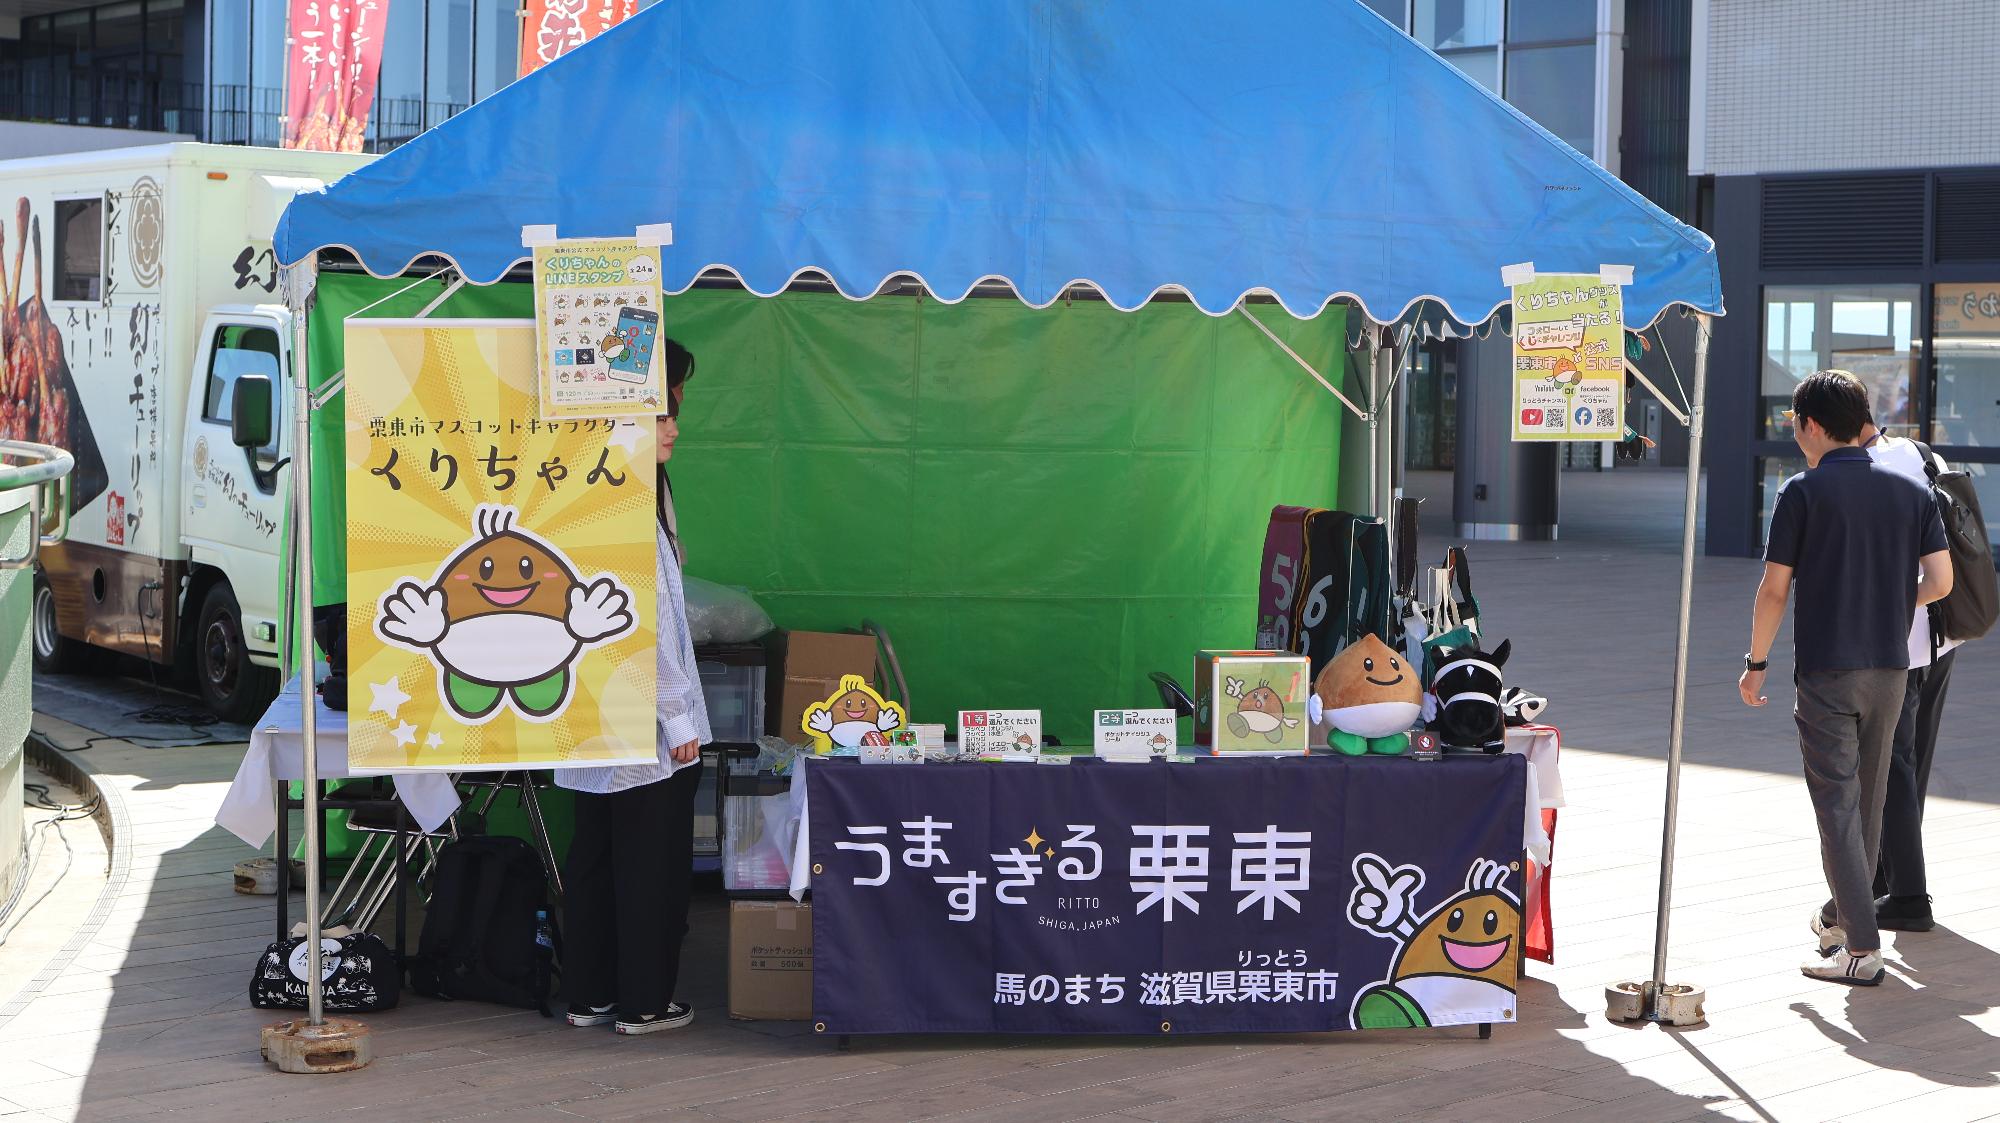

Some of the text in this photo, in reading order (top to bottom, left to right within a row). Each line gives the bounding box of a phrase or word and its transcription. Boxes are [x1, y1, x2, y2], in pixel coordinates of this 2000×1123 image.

[545, 271, 625, 285] LINE スタンプ
[1516, 355, 1623, 371] 栗東市 SNS
[369, 416, 636, 438] 栗東市マスコットキャラクター
[370, 445, 626, 491] くりちゃん
[1302, 574, 1333, 628] 6
[834, 815, 1312, 922] うますぎる 栗東
[1058, 897, 1100, 909] RITTO
[1082, 915, 1120, 931] JAPAN
[1238, 949, 1309, 968] りっとう
[285, 981, 337, 996] KAIA
[994, 968, 1339, 1006] 馬のまち 滋賀県栗東市
